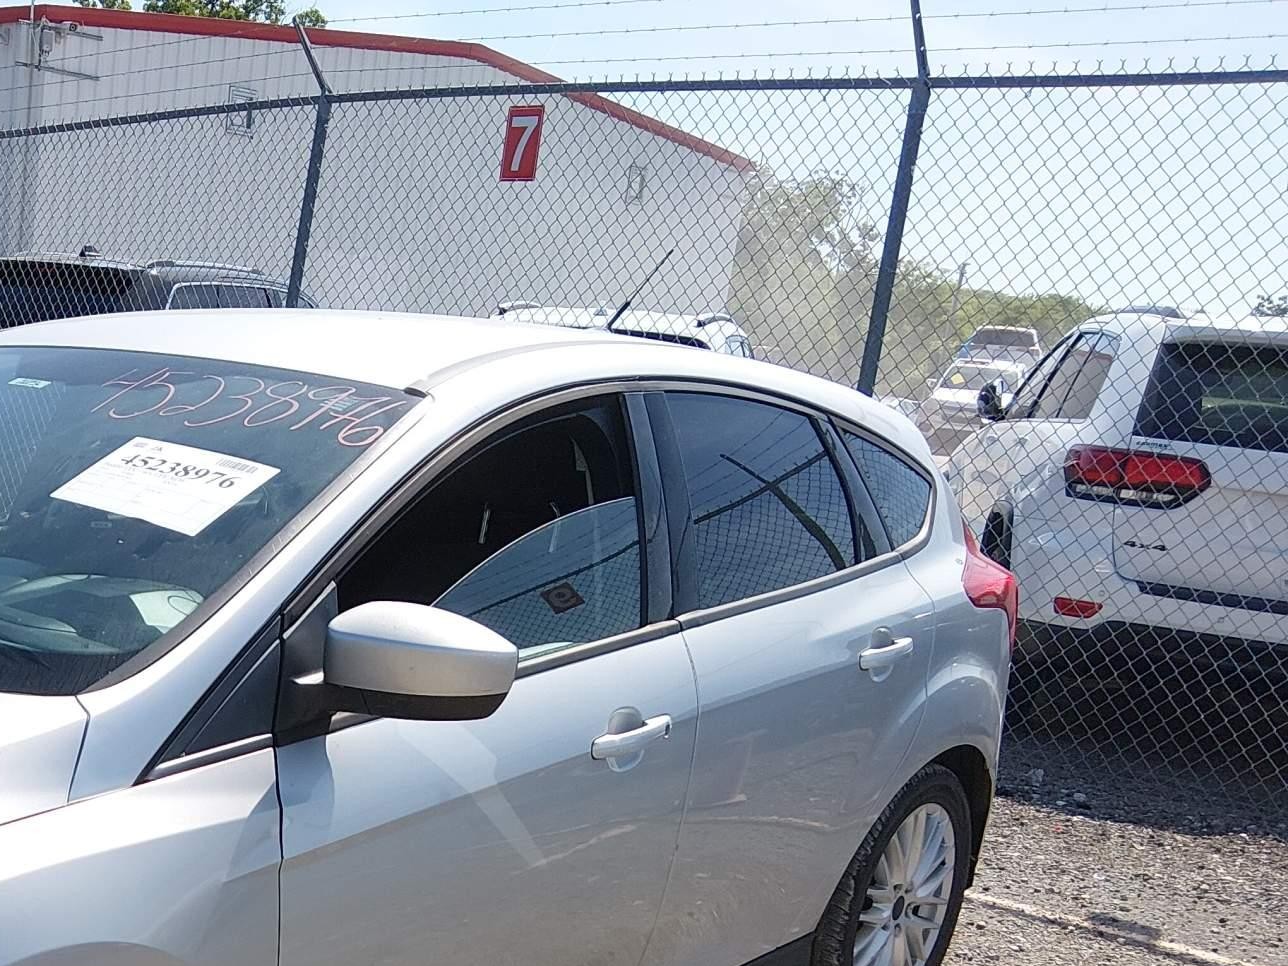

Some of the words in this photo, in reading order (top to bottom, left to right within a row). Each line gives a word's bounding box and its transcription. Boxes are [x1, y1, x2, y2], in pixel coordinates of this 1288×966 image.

[509, 115, 539, 172] 7
[90, 366, 408, 447] 45238976
[120, 453, 241, 489] 45238976
[1123, 540, 1168, 552] 4x4
